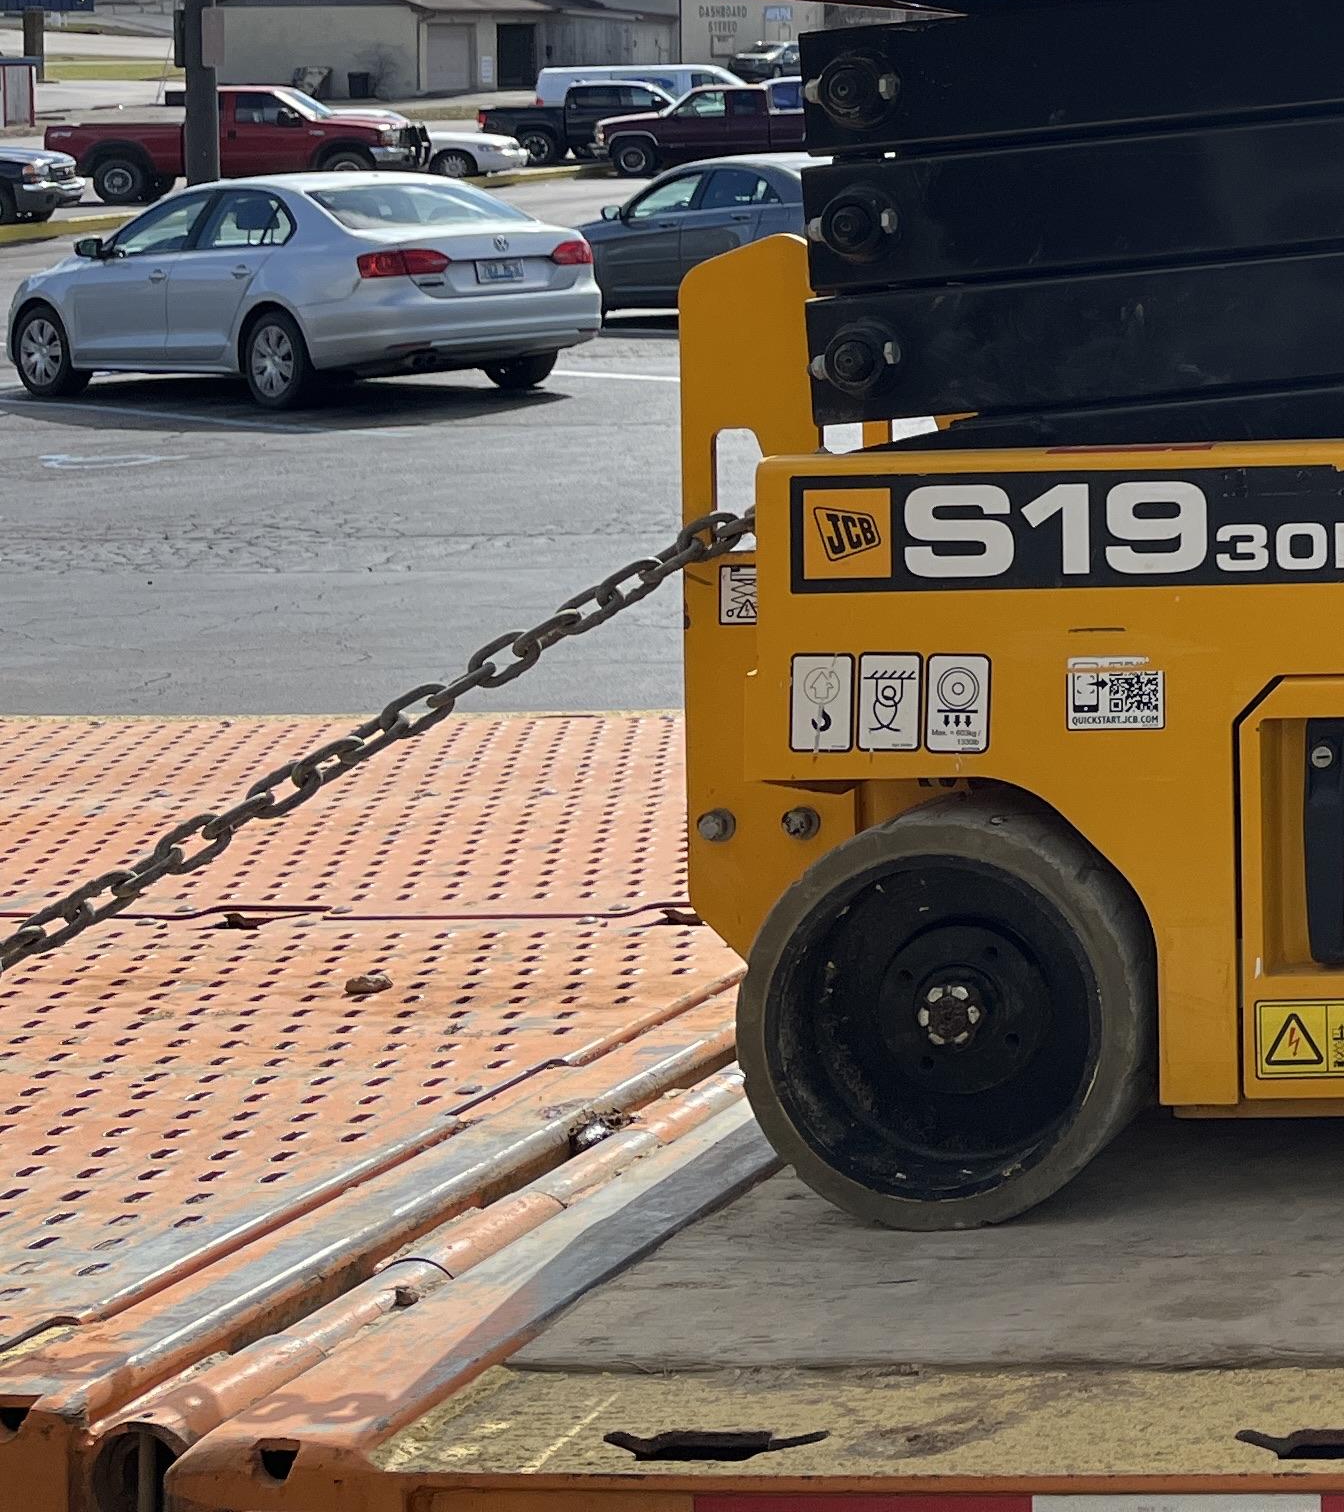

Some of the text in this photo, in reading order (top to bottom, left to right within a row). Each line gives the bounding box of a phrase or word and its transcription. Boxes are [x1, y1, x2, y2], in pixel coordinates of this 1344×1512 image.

[699, 6, 748, 19] DASHBOARD
[708, 20, 738, 34] STEREO
[825, 512, 877, 557] JCB
[1072, 715, 1159, 726] QUICKSTART.JCB.COM
